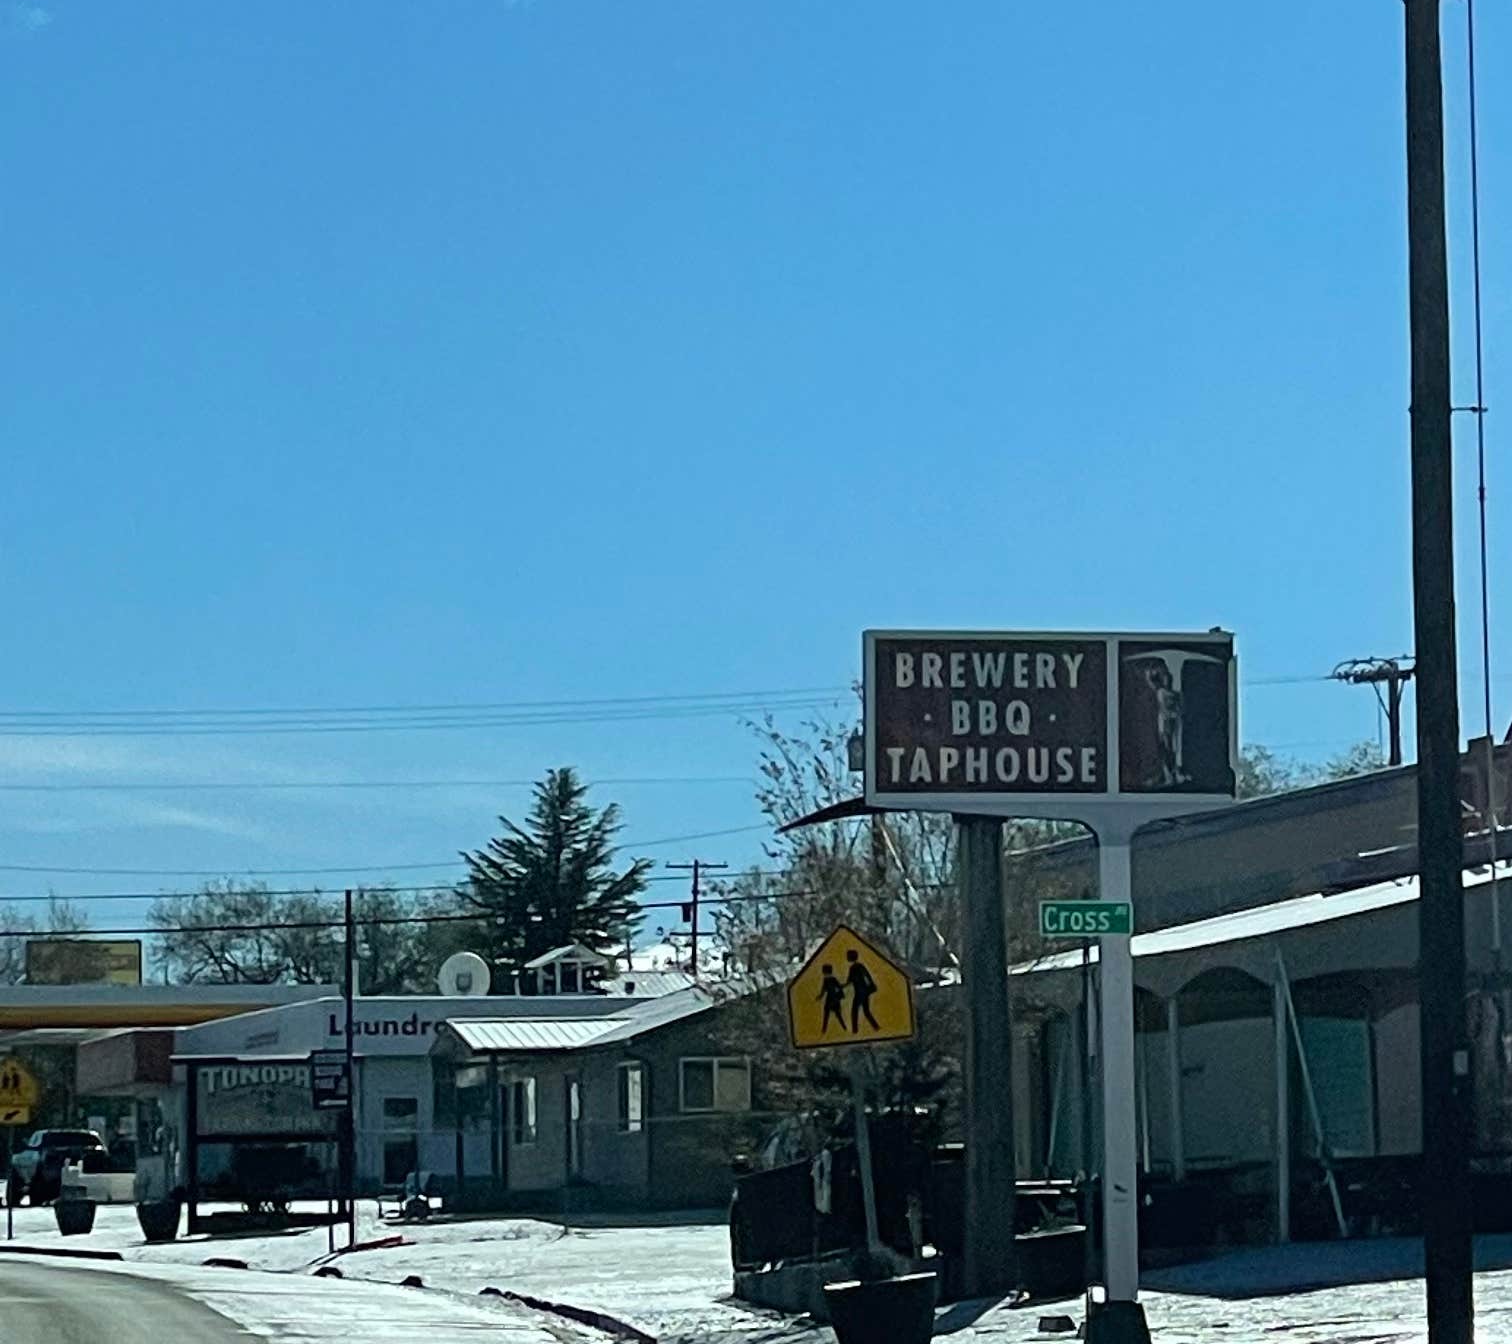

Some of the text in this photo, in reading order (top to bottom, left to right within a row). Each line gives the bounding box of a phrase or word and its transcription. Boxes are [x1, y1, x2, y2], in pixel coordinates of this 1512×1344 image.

[896, 652, 1084, 689] BREWERY
[951, 700, 1031, 736] BBQ
[886, 747, 1097, 784] TAPHOUSE
[1044, 906, 1111, 932] Cross
